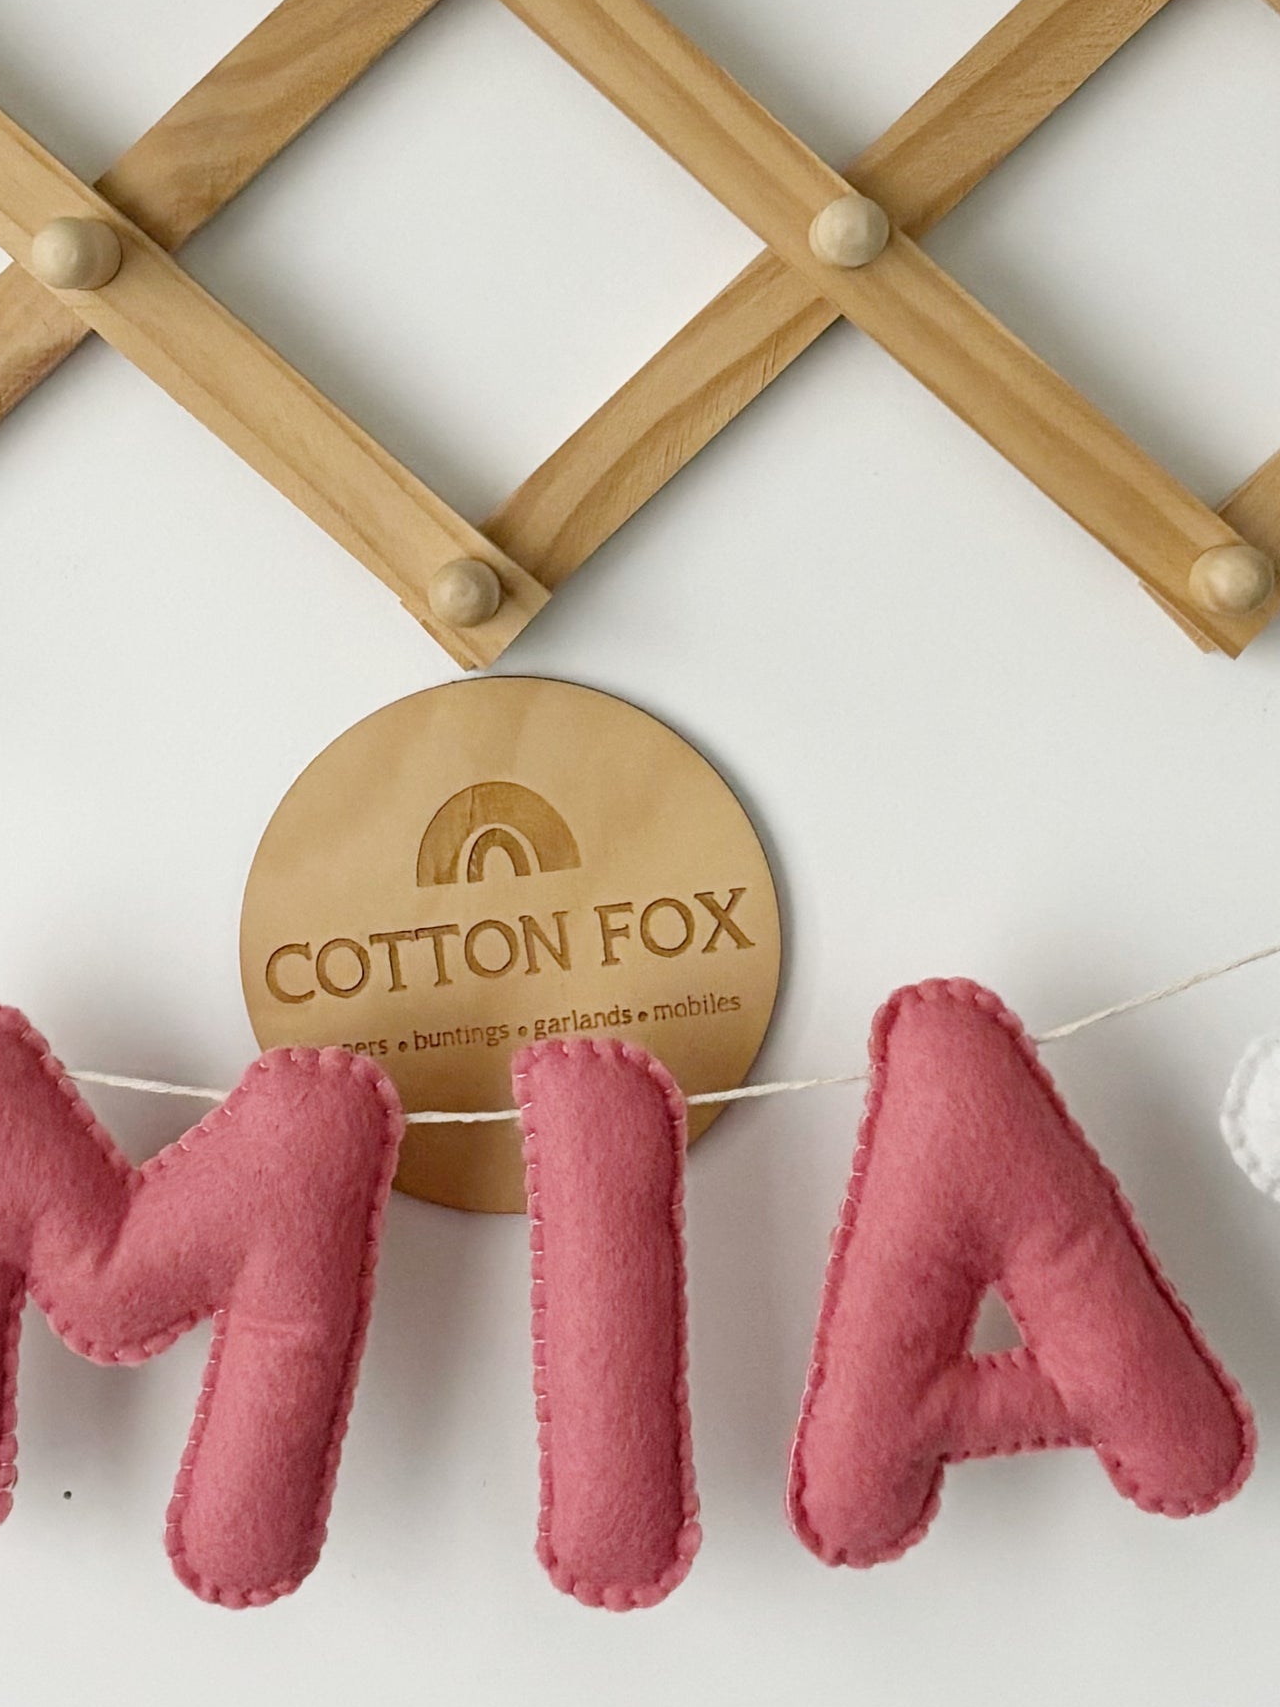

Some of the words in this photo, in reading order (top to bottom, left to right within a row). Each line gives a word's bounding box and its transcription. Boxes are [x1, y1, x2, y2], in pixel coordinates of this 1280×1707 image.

[265, 910, 572, 1004] COTTON
[593, 887, 756, 966] FOX
[413, 1021, 511, 1052] buntings
[534, 1004, 633, 1040] garlands
[653, 992, 742, 1022] mobiles
